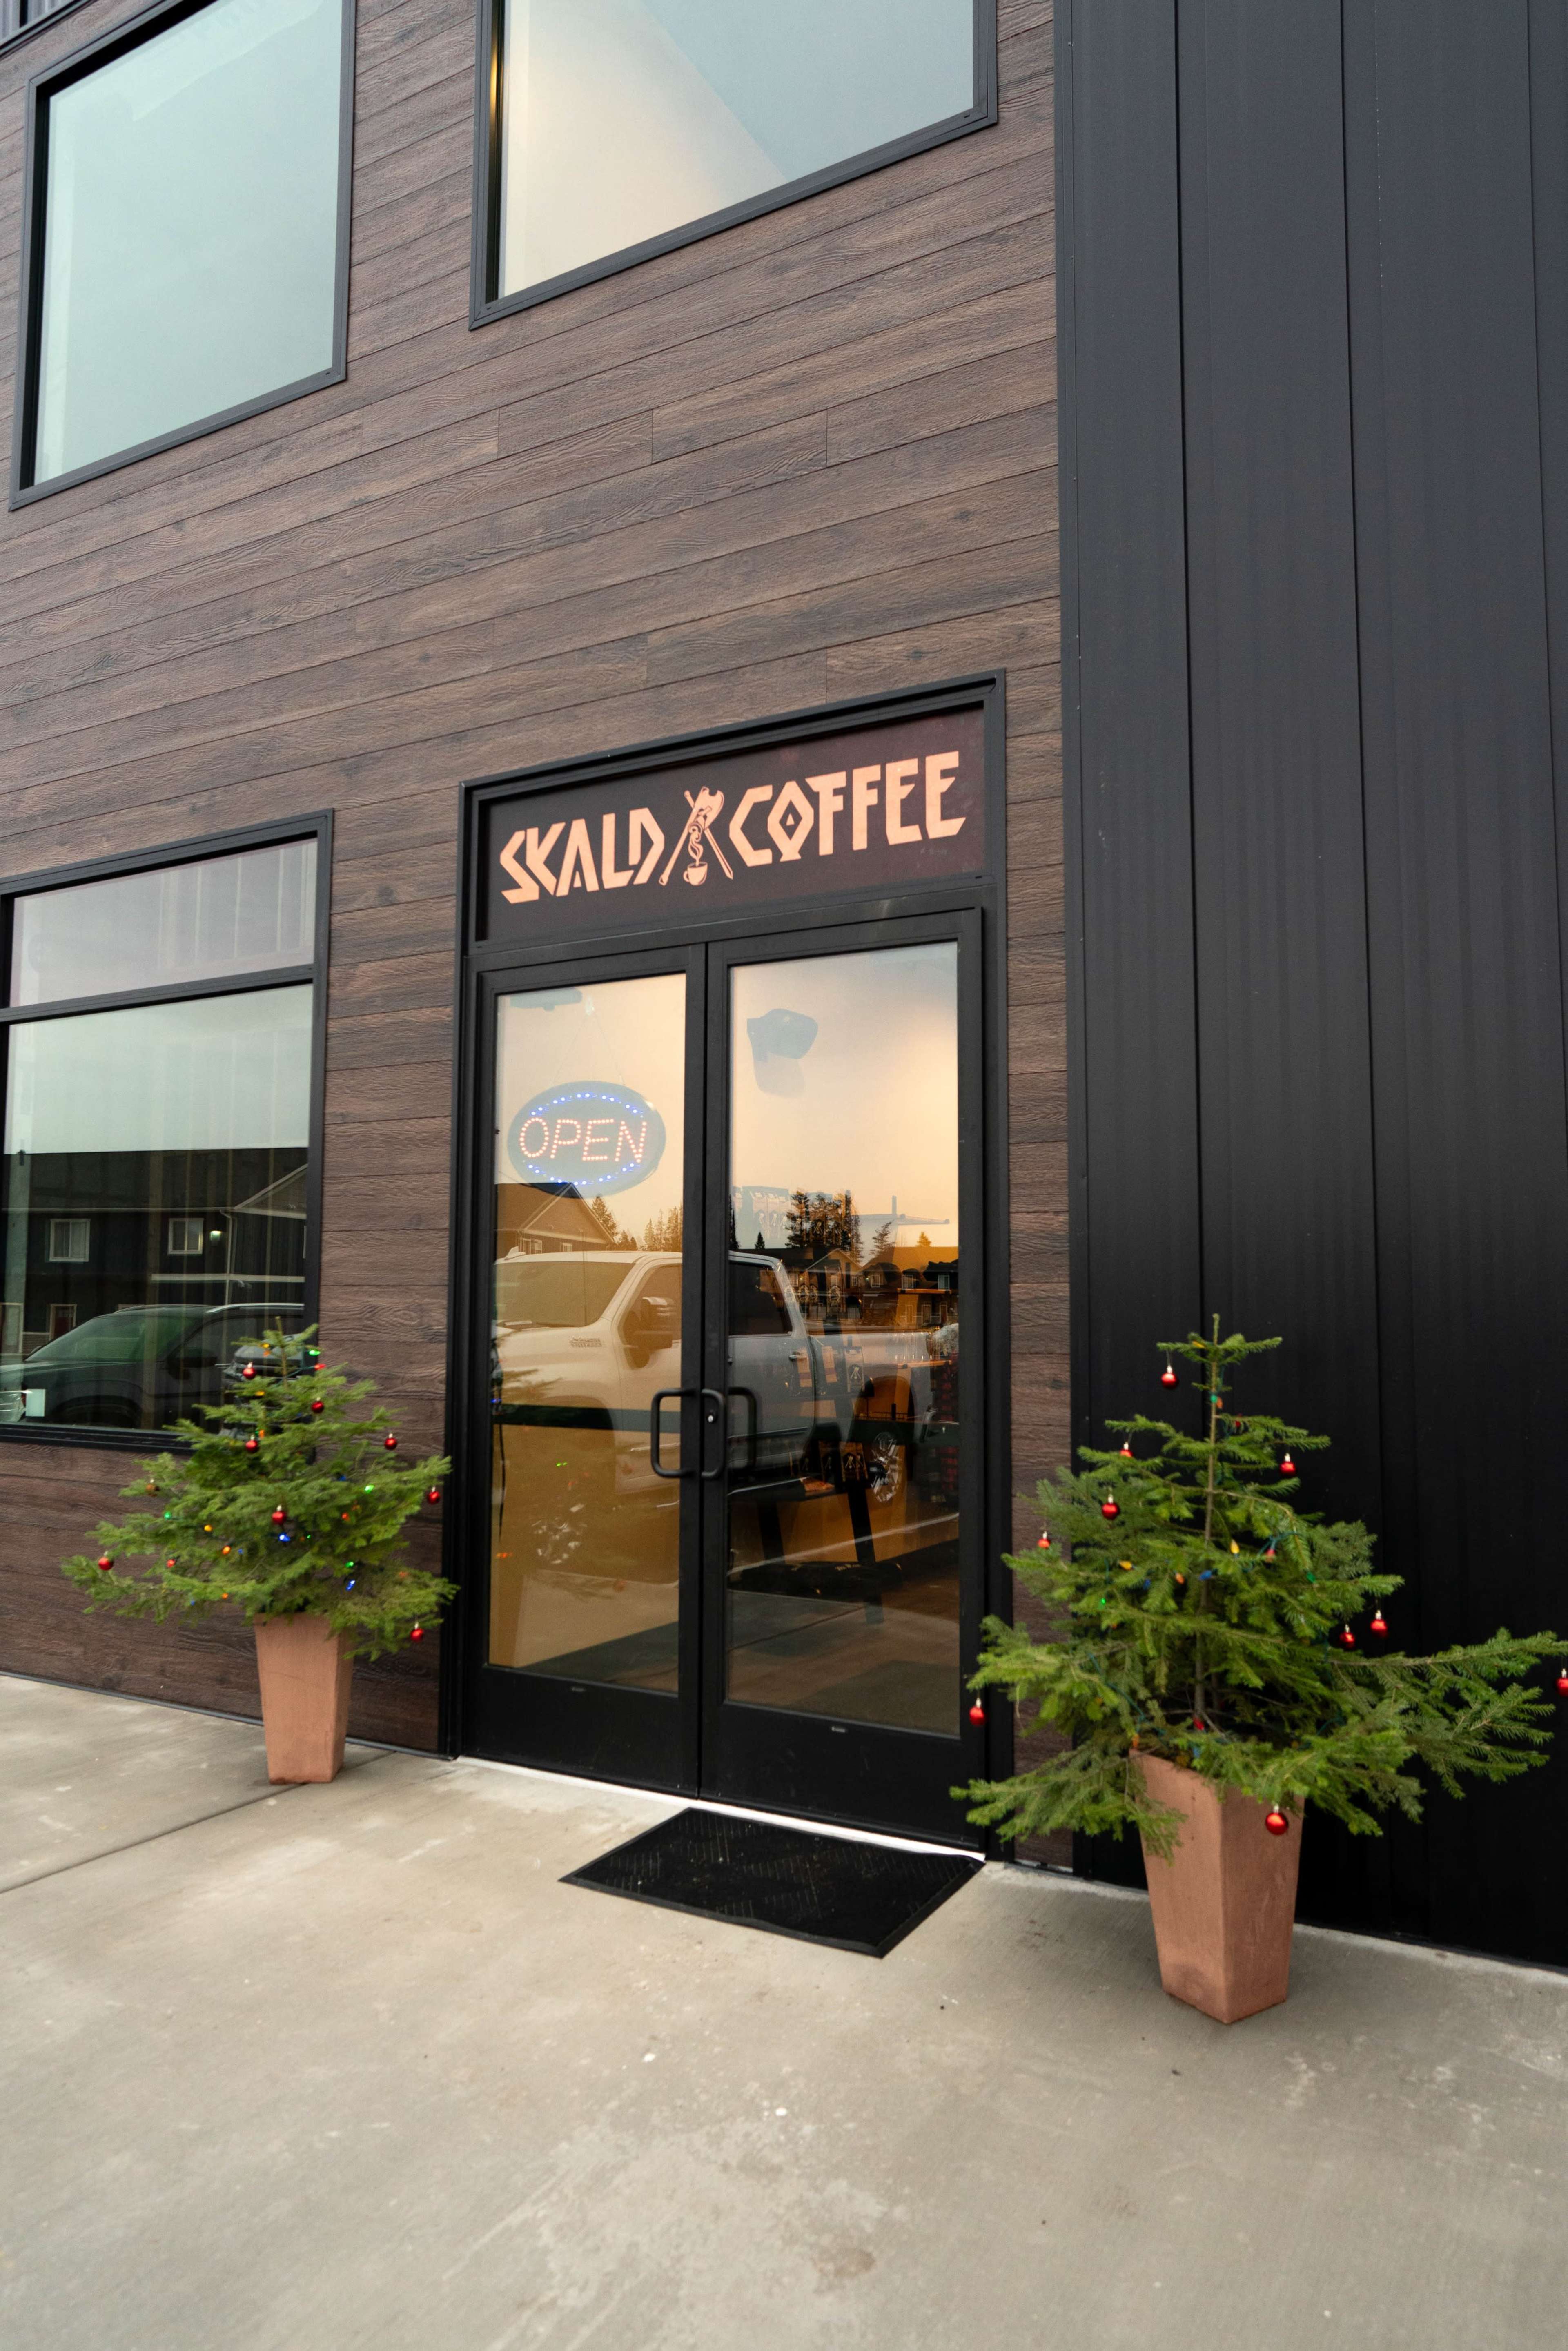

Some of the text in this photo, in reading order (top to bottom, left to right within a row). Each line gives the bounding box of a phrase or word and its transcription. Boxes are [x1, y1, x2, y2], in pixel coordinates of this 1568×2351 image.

[499, 751, 967, 904] SKALD COFFEE
[519, 1117, 647, 1163] OPEN
